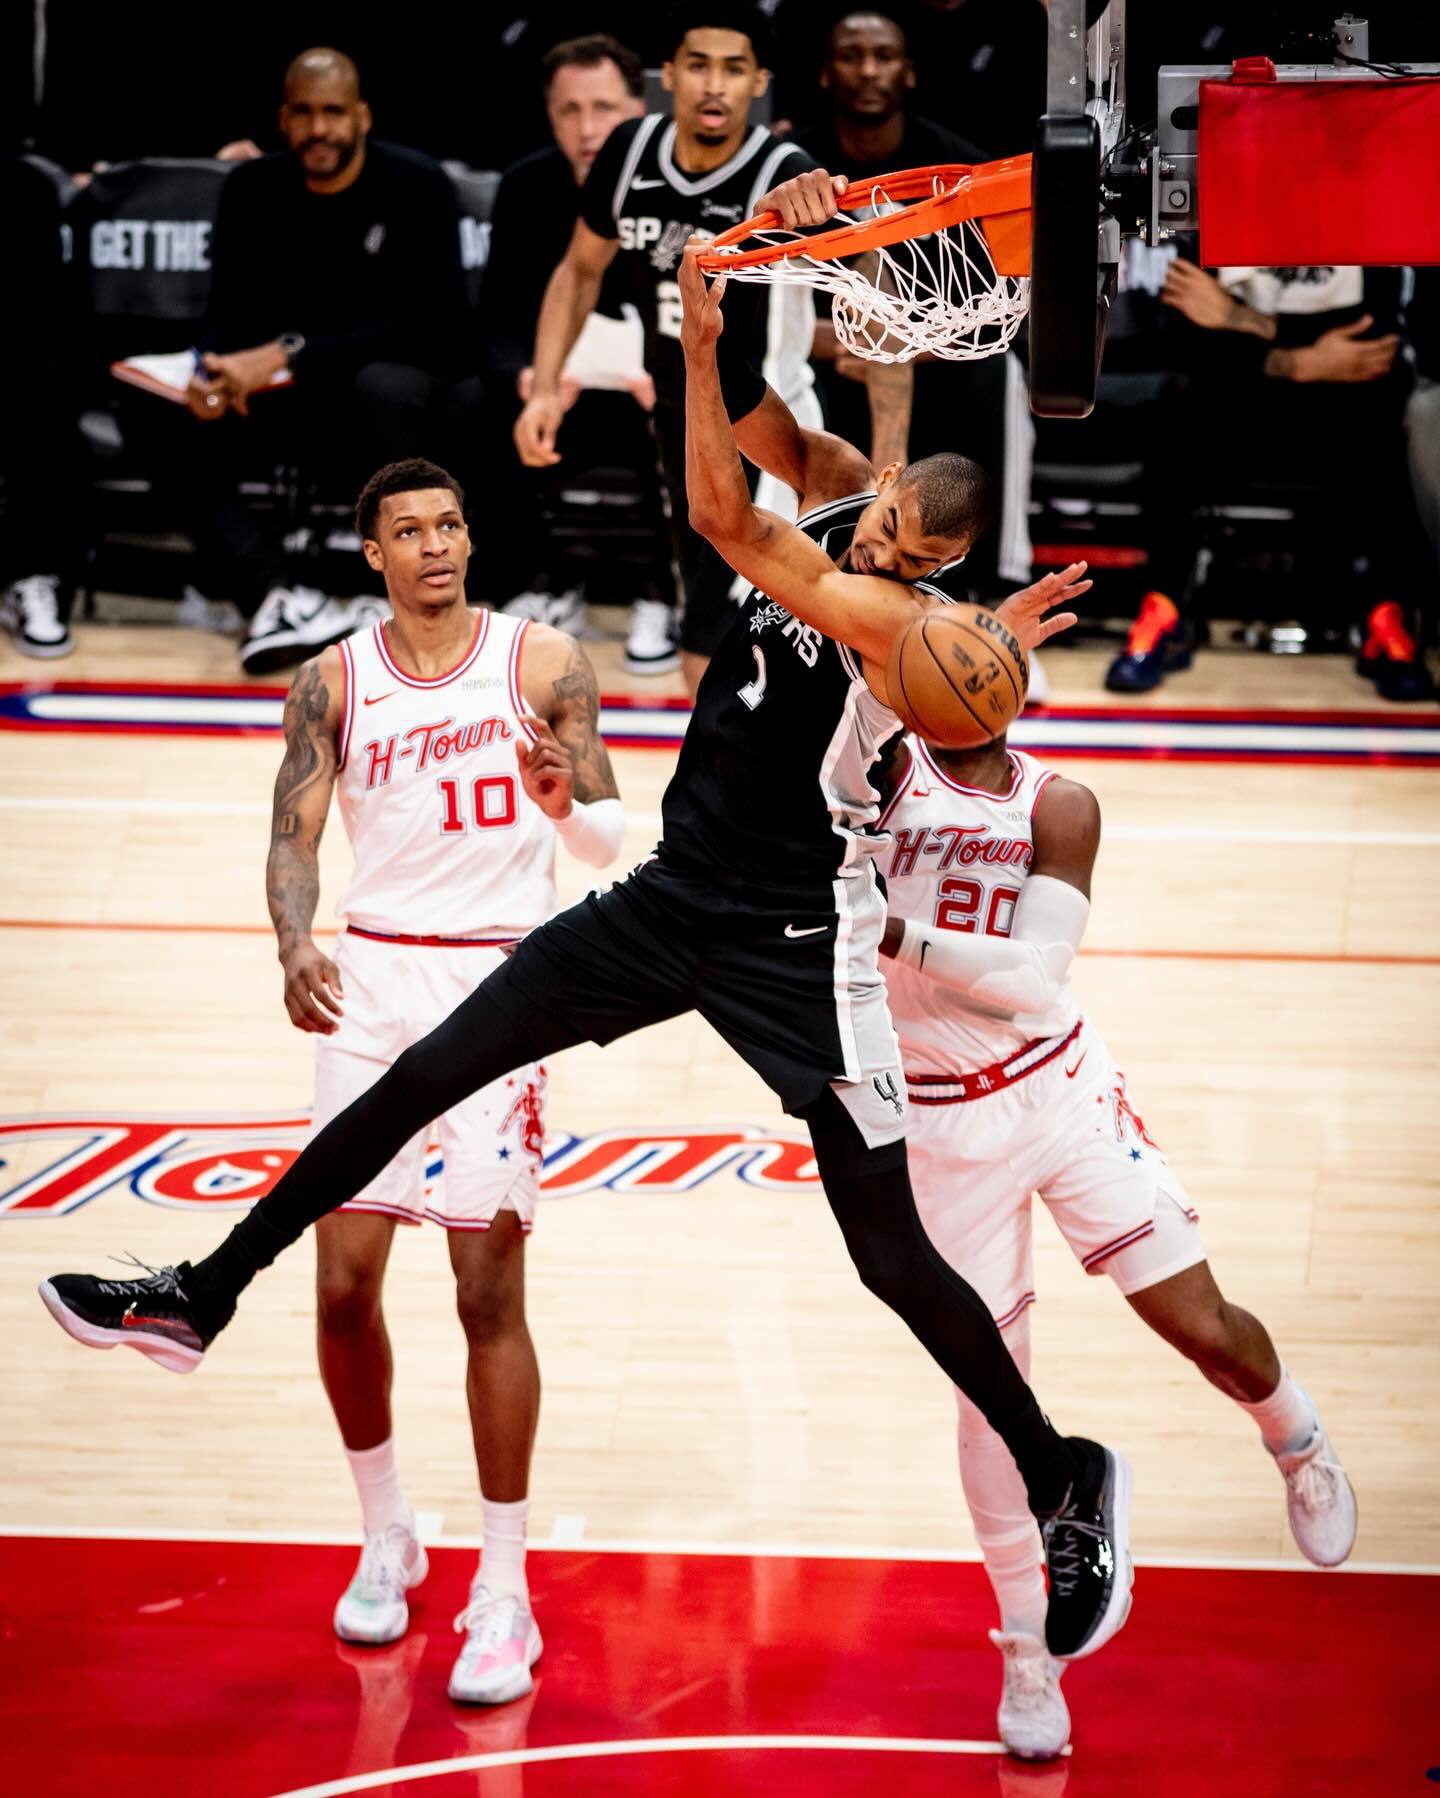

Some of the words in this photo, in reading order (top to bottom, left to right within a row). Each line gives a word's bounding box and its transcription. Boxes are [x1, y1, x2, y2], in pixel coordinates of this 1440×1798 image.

[90, 219, 146, 271] GET
[151, 220, 213, 272] THE
[737, 644, 768, 711] 1
[365, 715, 514, 789] H-Town
[437, 772, 520, 836] 10
[889, 824, 1034, 878] H-Town
[932, 874, 1021, 939] 20
